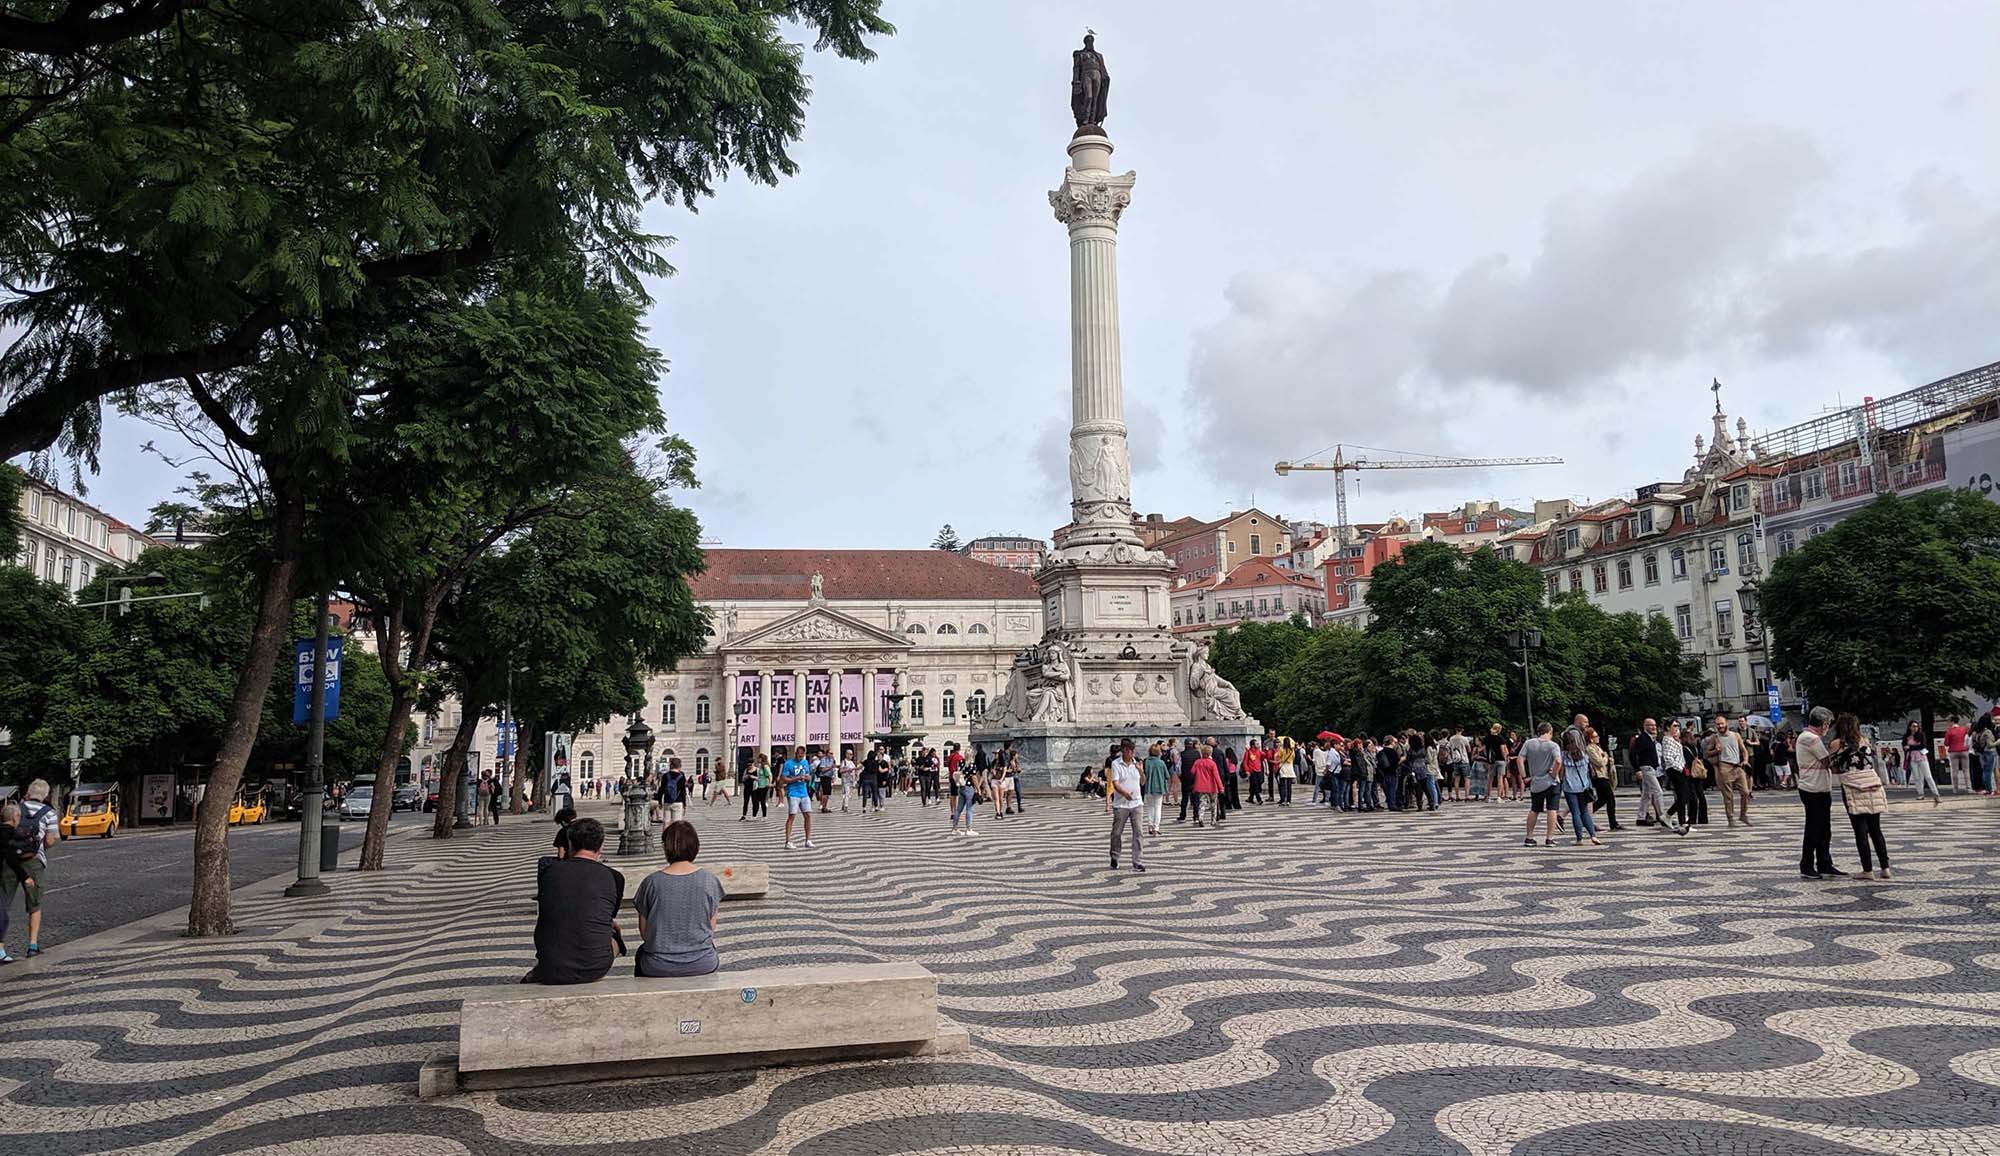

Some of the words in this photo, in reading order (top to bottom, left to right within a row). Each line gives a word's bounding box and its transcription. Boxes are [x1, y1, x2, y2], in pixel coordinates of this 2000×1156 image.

[741, 680, 789, 697] ARTE
[806, 679, 843, 695] FAZ
[741, 734, 756, 743] ART
[771, 733, 795, 742] MAKES
